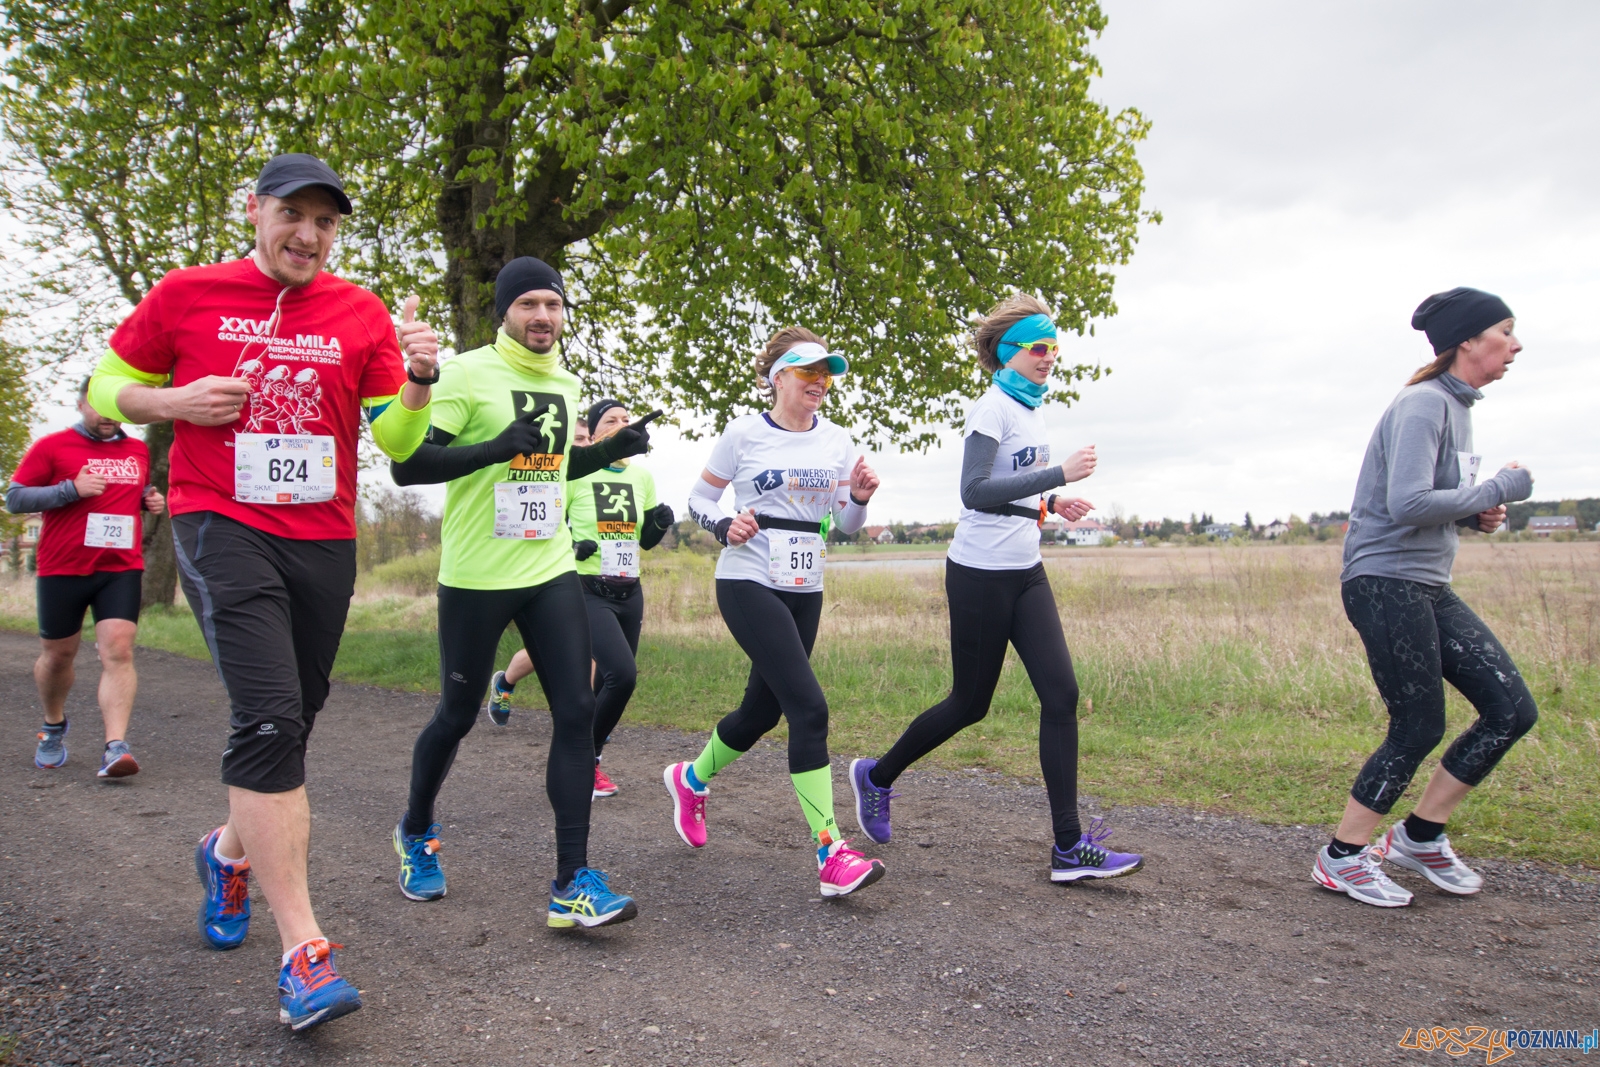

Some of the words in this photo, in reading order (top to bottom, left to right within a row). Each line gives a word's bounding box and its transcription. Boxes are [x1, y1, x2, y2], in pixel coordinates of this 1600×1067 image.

[218, 316, 271, 336] XXVI
[296, 334, 341, 351] MILA
[319, 356, 336, 364] 2014
[524, 454, 555, 469] night
[89, 466, 139, 477] SZPIKU
[268, 458, 308, 482] 624
[508, 469, 560, 482] runners
[788, 477, 830, 489] ZADYSZKA
[520, 502, 546, 521] 763
[103, 525, 122, 537] 723
[606, 521, 630, 532] night
[616, 553, 633, 566] 762
[790, 552, 813, 570] 513
